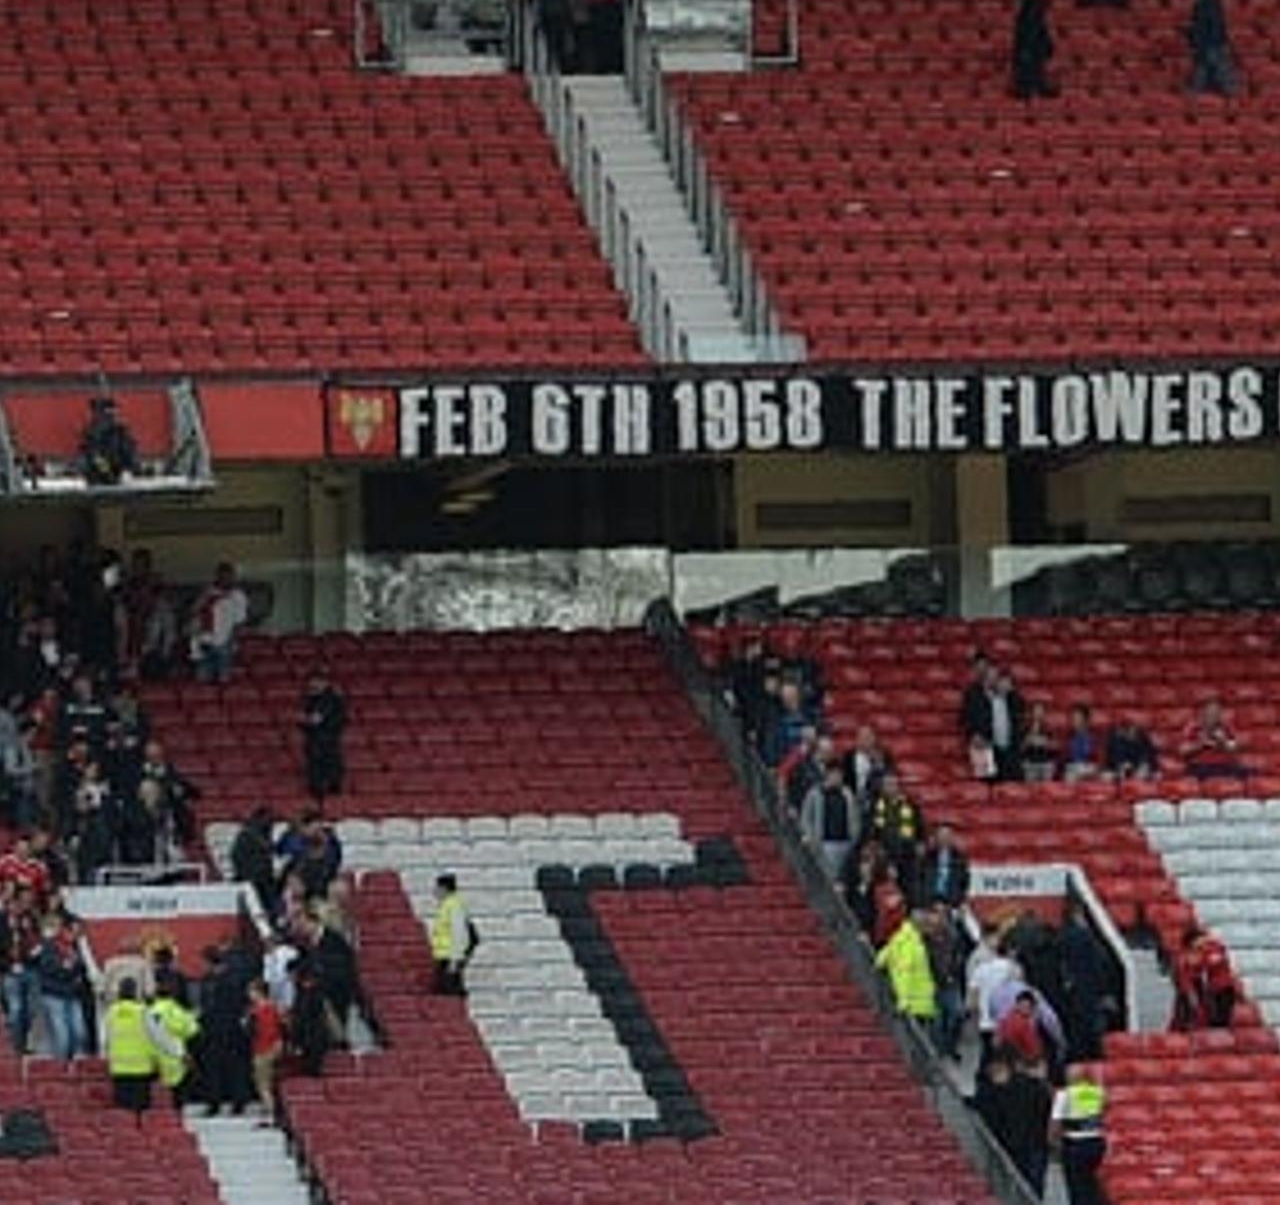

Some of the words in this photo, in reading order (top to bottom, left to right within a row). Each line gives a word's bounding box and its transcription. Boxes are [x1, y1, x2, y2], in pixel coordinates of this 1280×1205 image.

[399, 386, 508, 456] FEB
[531, 382, 651, 456] 6TH
[672, 380, 821, 453] 1958
[854, 378, 968, 451] THE
[982, 367, 1263, 451] FLOWERS
